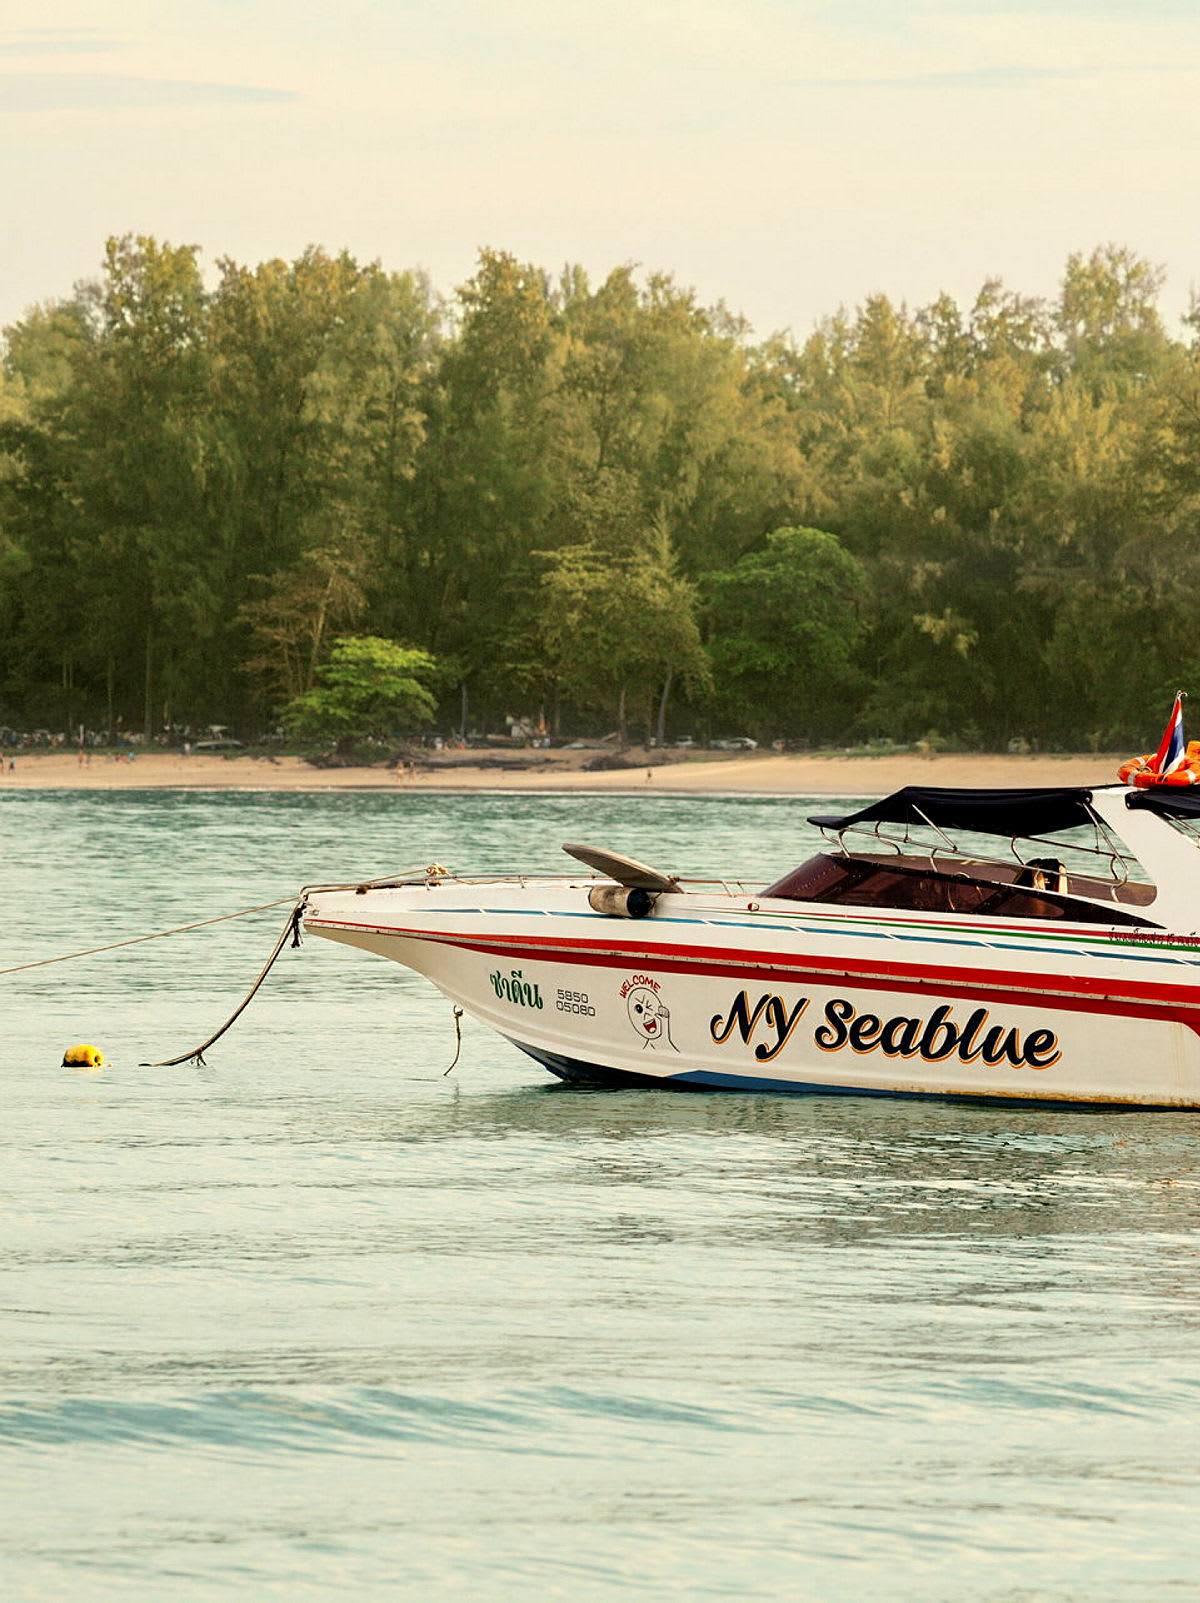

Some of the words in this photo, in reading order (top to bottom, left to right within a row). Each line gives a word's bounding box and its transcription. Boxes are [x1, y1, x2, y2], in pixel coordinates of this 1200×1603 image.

[556, 988, 589, 1004] 5850
[619, 974, 661, 999] WELCOME
[556, 1000, 596, 1017] 05080
[814, 998, 1062, 1070] Seablue
